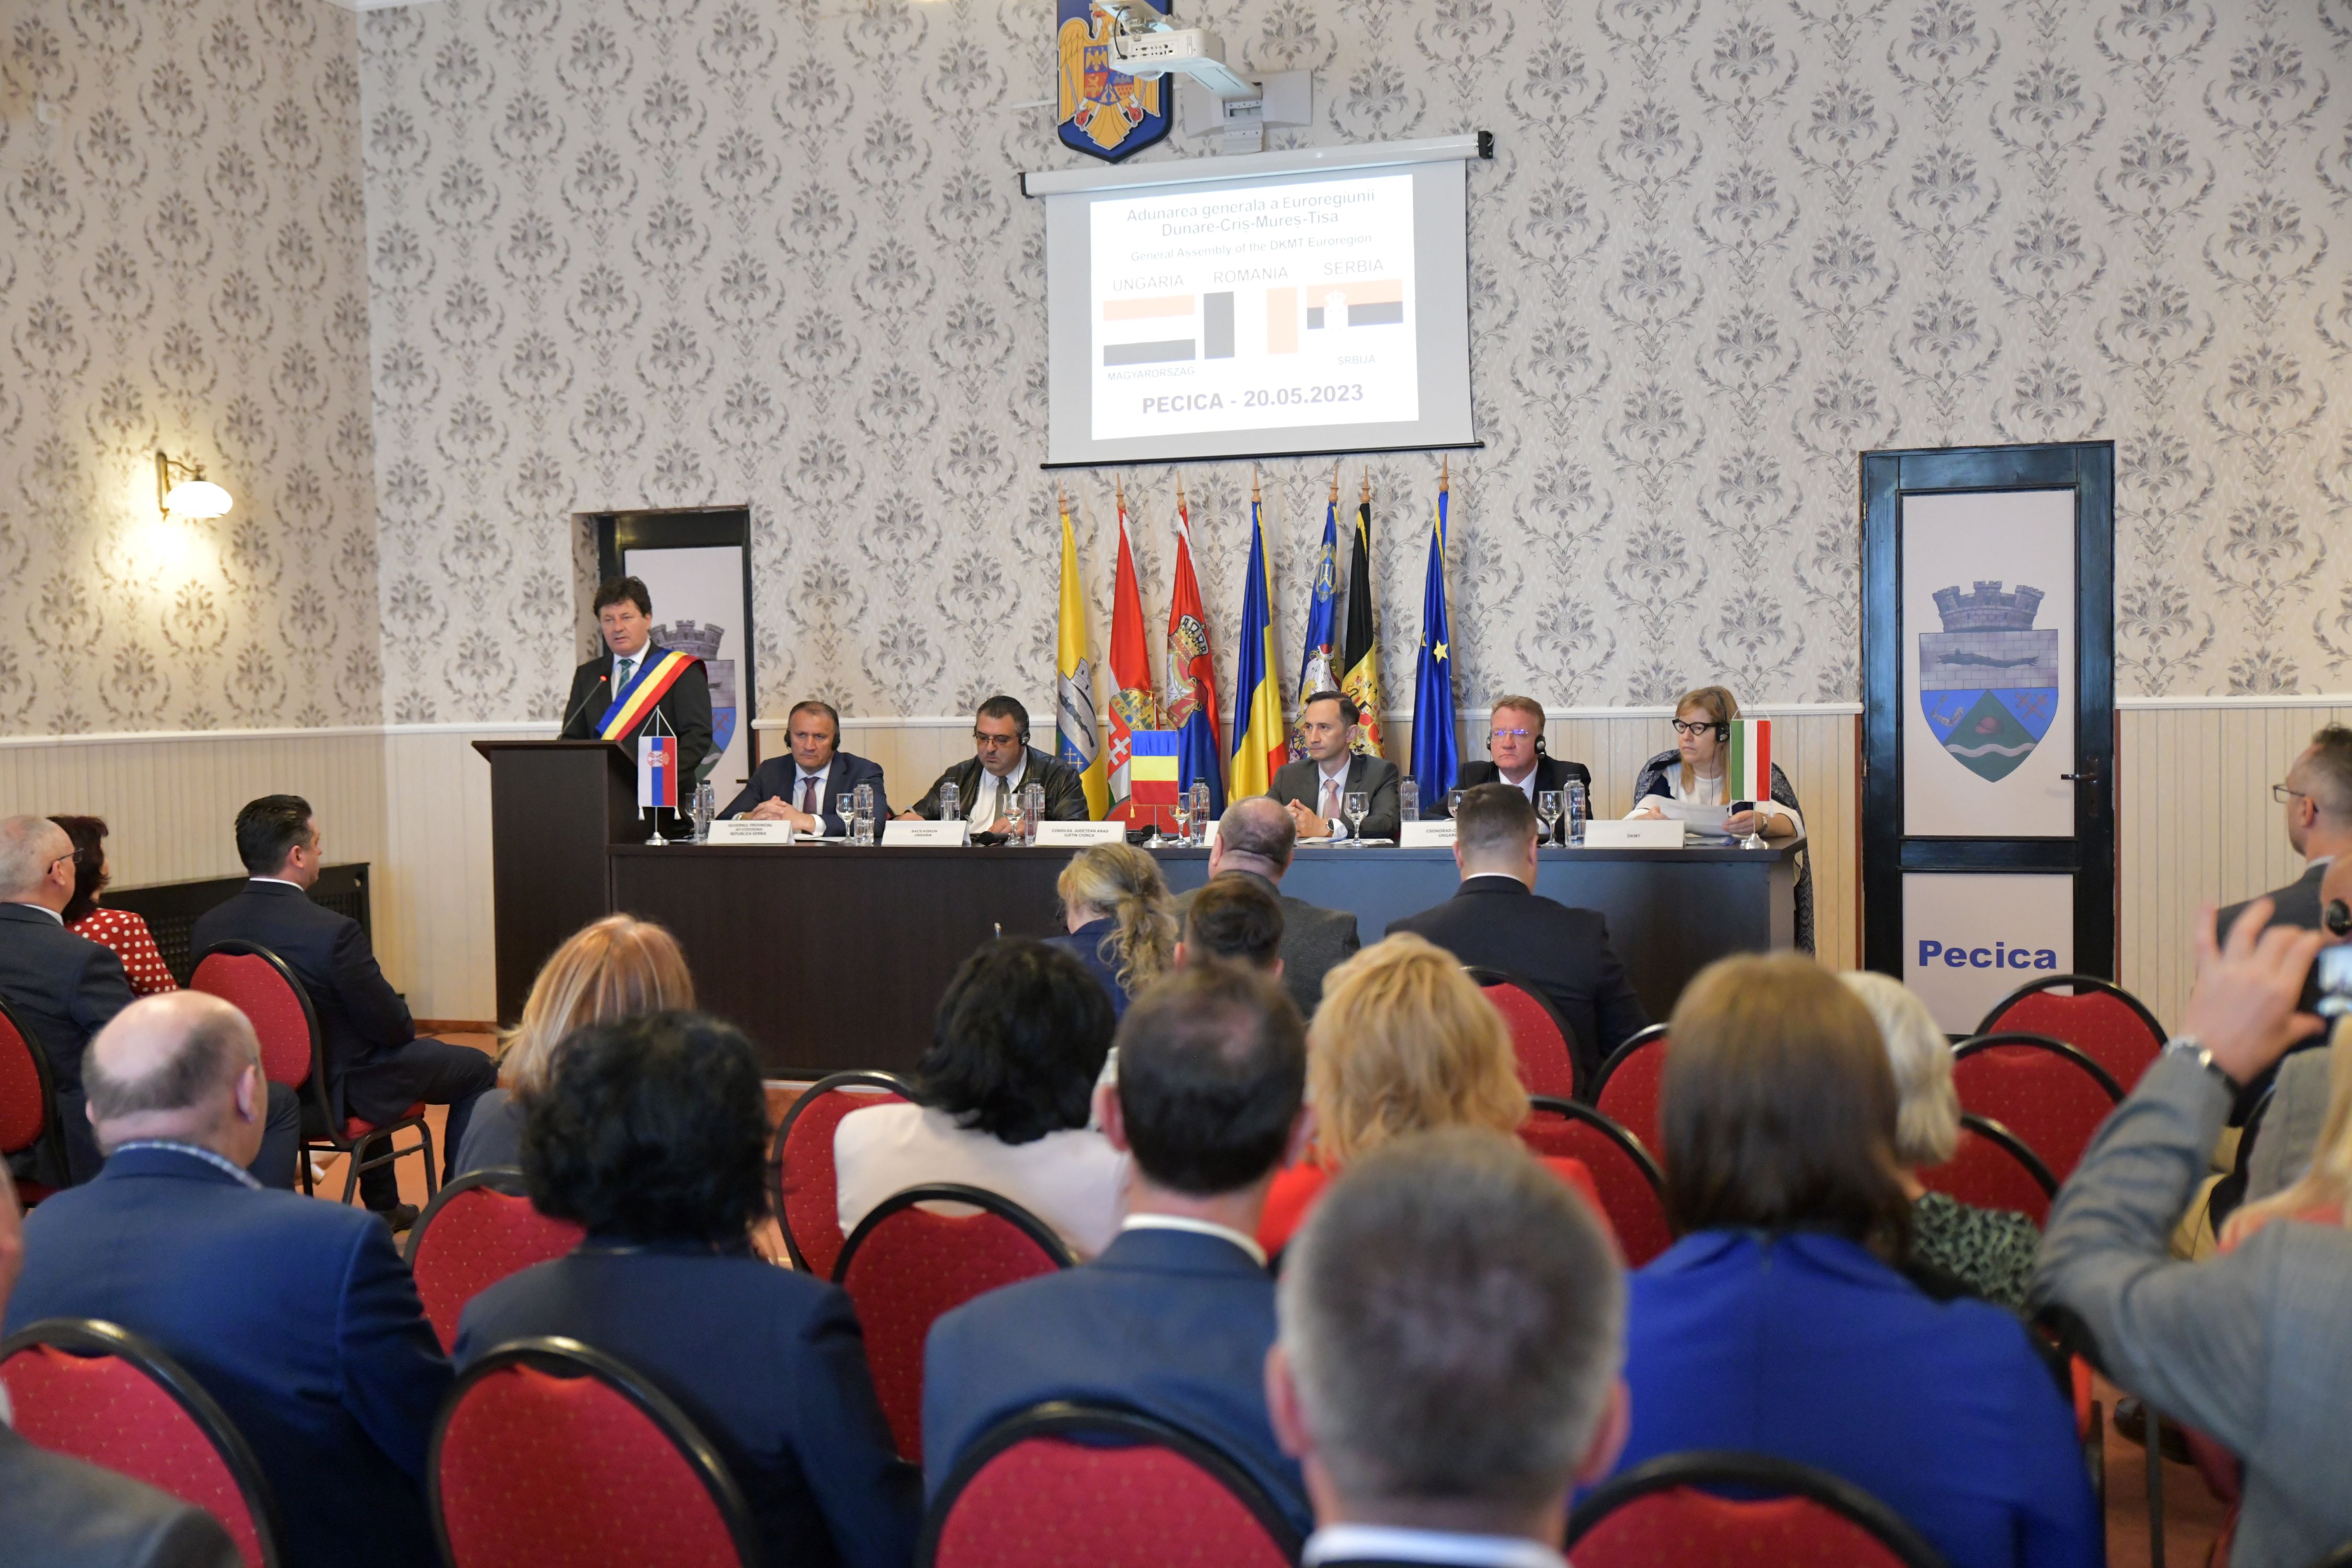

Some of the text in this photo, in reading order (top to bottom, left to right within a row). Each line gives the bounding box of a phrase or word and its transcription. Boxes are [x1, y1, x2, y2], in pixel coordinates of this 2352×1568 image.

[1127, 188, 1374, 222] Adunarea generala a Euroregiunii
[1131, 235, 1371, 261] General Assembly of the DKMT Euroregion
[1214, 267, 1288, 283] ROMANIA
[1324, 259, 1383, 275] SERBIA
[1113, 274, 1184, 292] UNGARIA
[1338, 355, 1376, 365] SRBIJA
[1143, 393, 1224, 414] PECICA
[1243, 384, 1364, 408] 20.05.2023
[1919, 940, 2057, 970] Pecica
